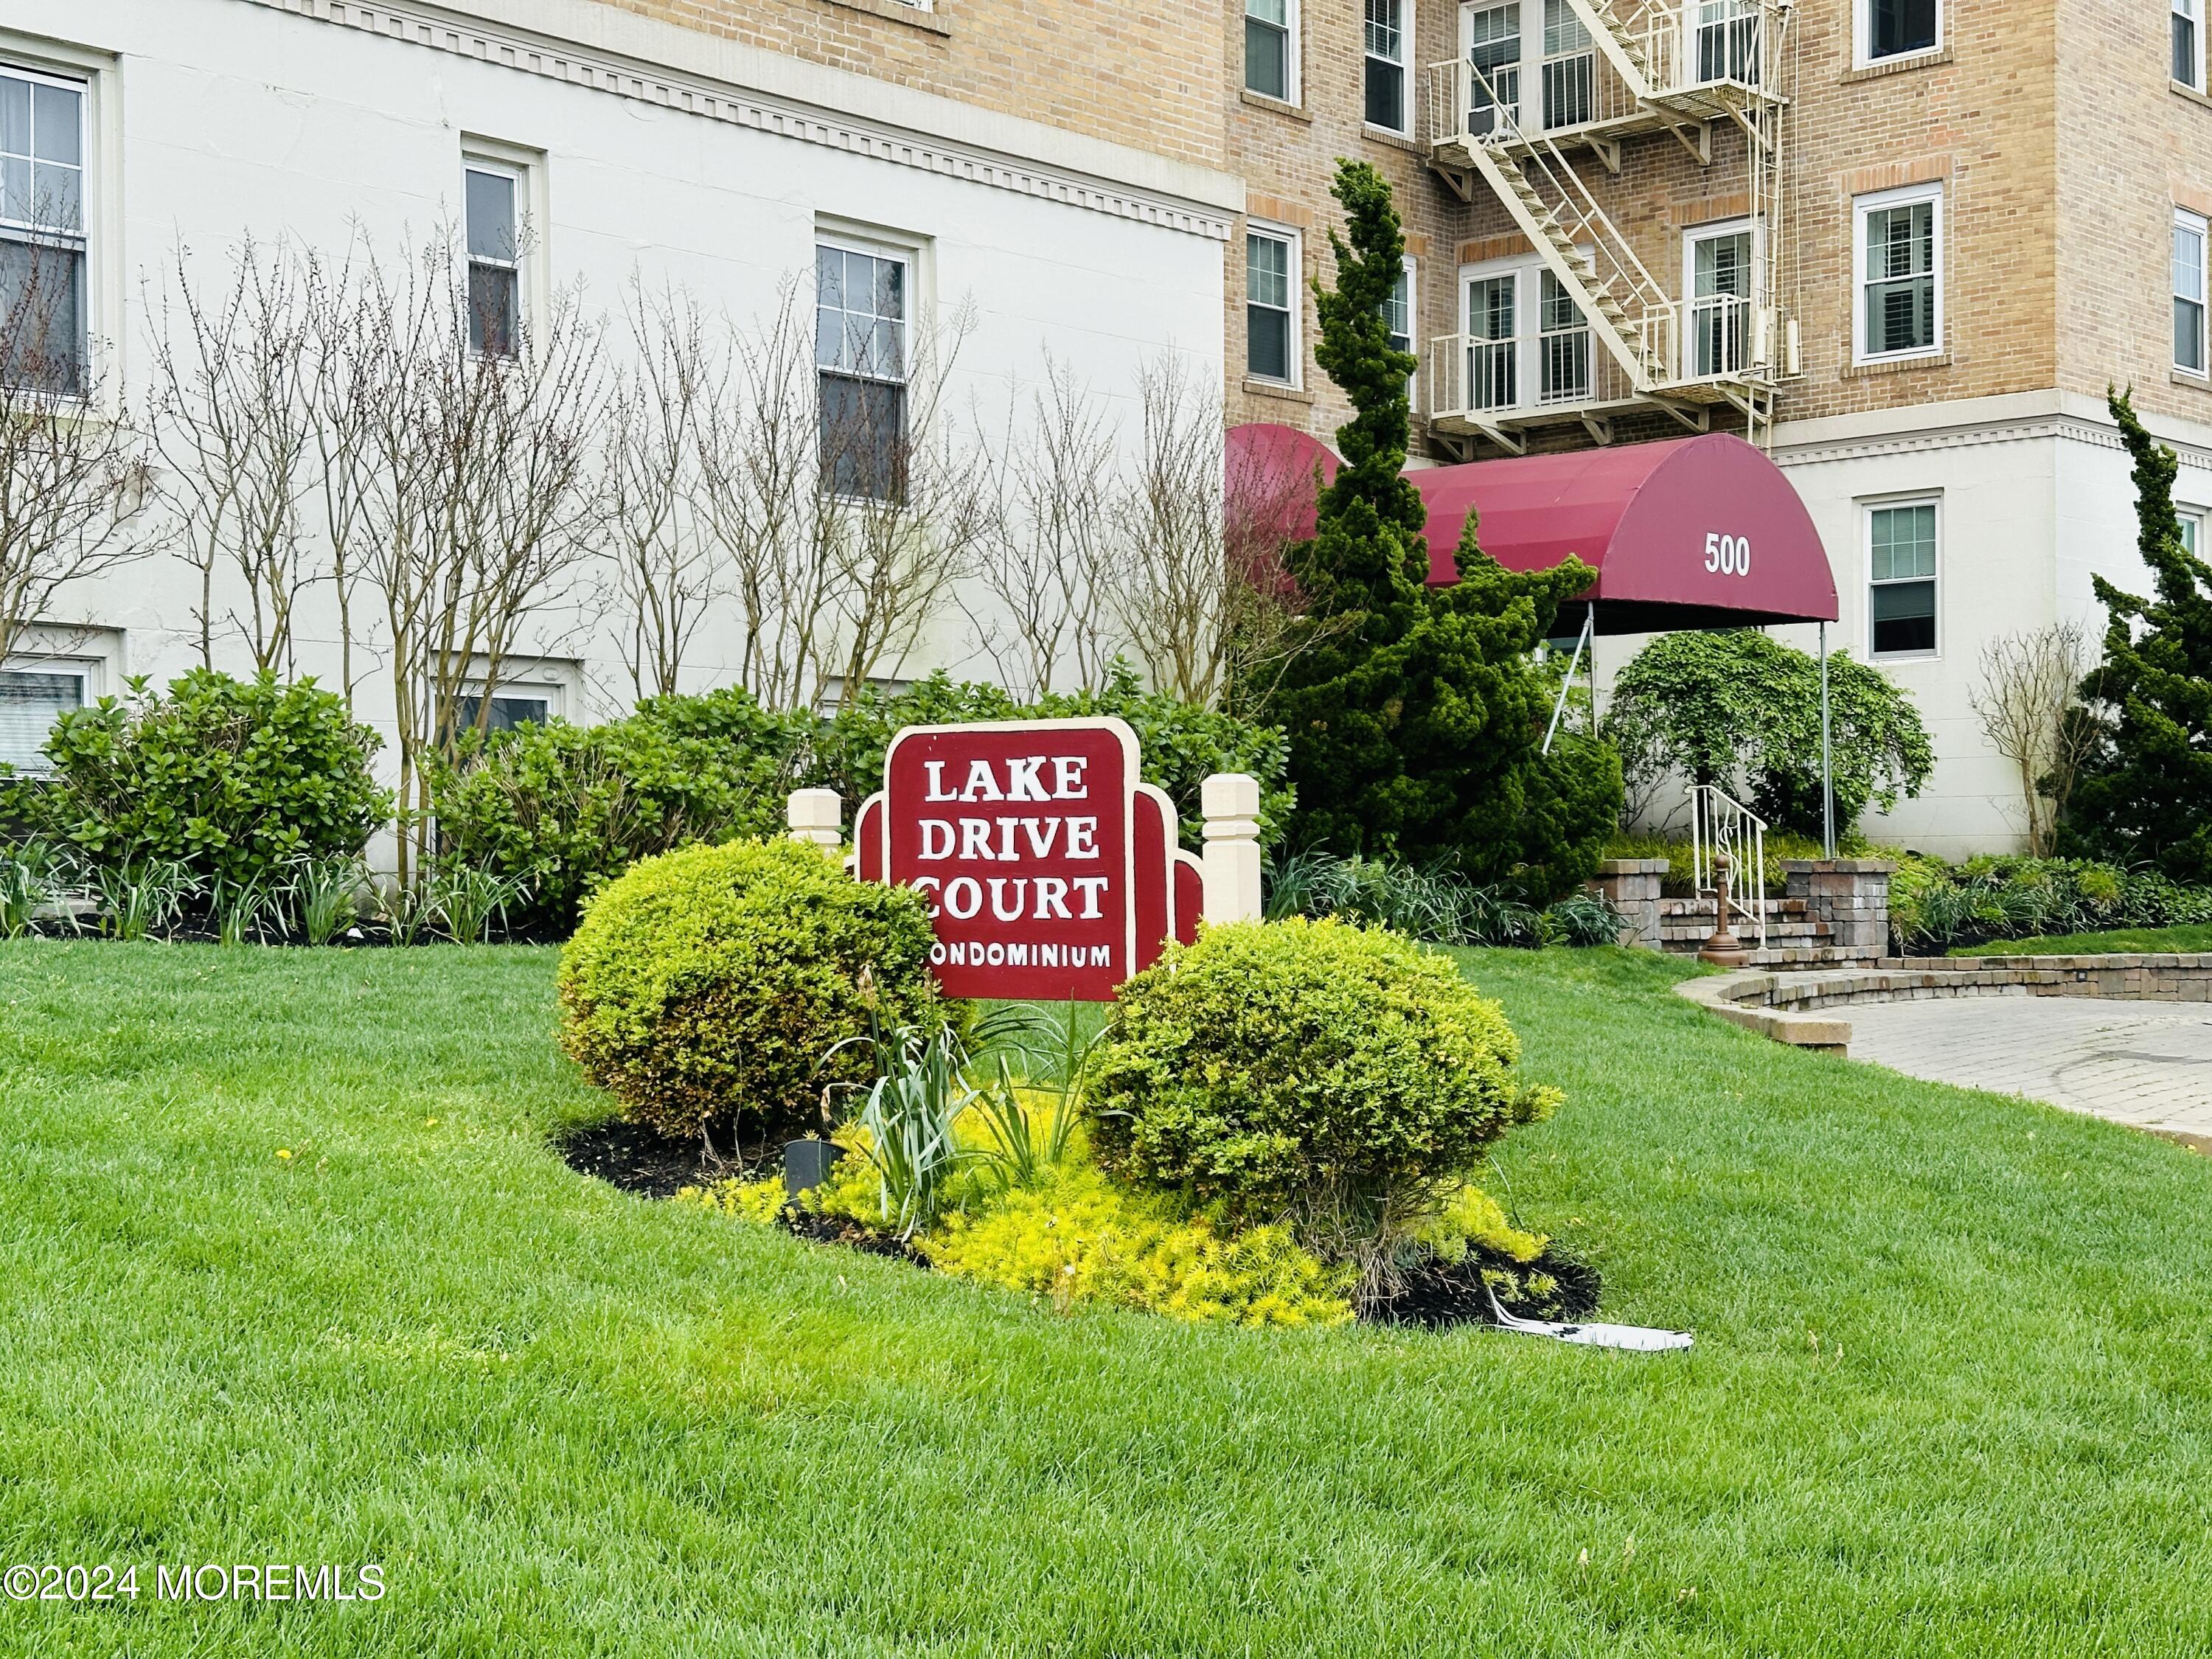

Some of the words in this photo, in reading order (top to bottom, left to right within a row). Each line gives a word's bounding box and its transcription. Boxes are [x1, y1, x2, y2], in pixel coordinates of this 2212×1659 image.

[1705, 532, 1750, 577] 500
[923, 756, 1088, 803] LAKE
[917, 816, 1100, 861] DRIVE
[919, 942, 1111, 968] ONDOMINIUM
